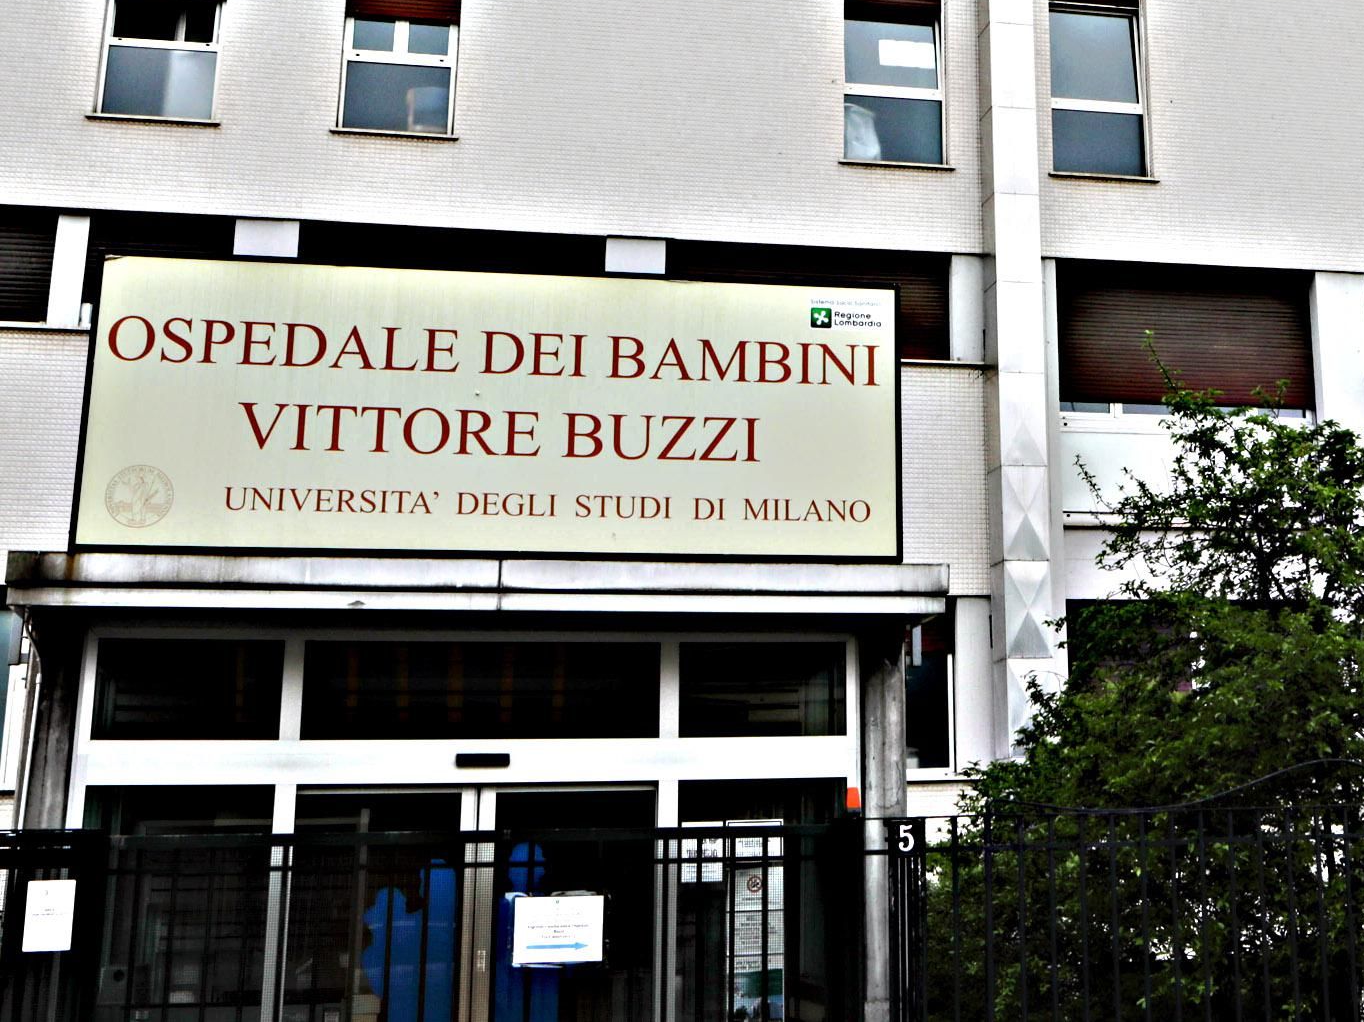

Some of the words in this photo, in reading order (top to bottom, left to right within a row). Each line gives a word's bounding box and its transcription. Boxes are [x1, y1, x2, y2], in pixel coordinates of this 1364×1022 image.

[834, 311, 872, 320] Regione
[834, 319, 882, 327] Lombardia
[107, 315, 459, 375] OSPEDALE
[482, 331, 584, 379] DEI
[608, 335, 880, 387] BAMBINI
[240, 402, 540, 457] VITTORE
[562, 413, 760, 463] BUZZI
[456, 492, 557, 519] DEGLI
[575, 493, 672, 520] STUDI
[693, 496, 726, 521] DI
[743, 498, 872, 524] MILANO
[898, 824, 915, 852] 5
